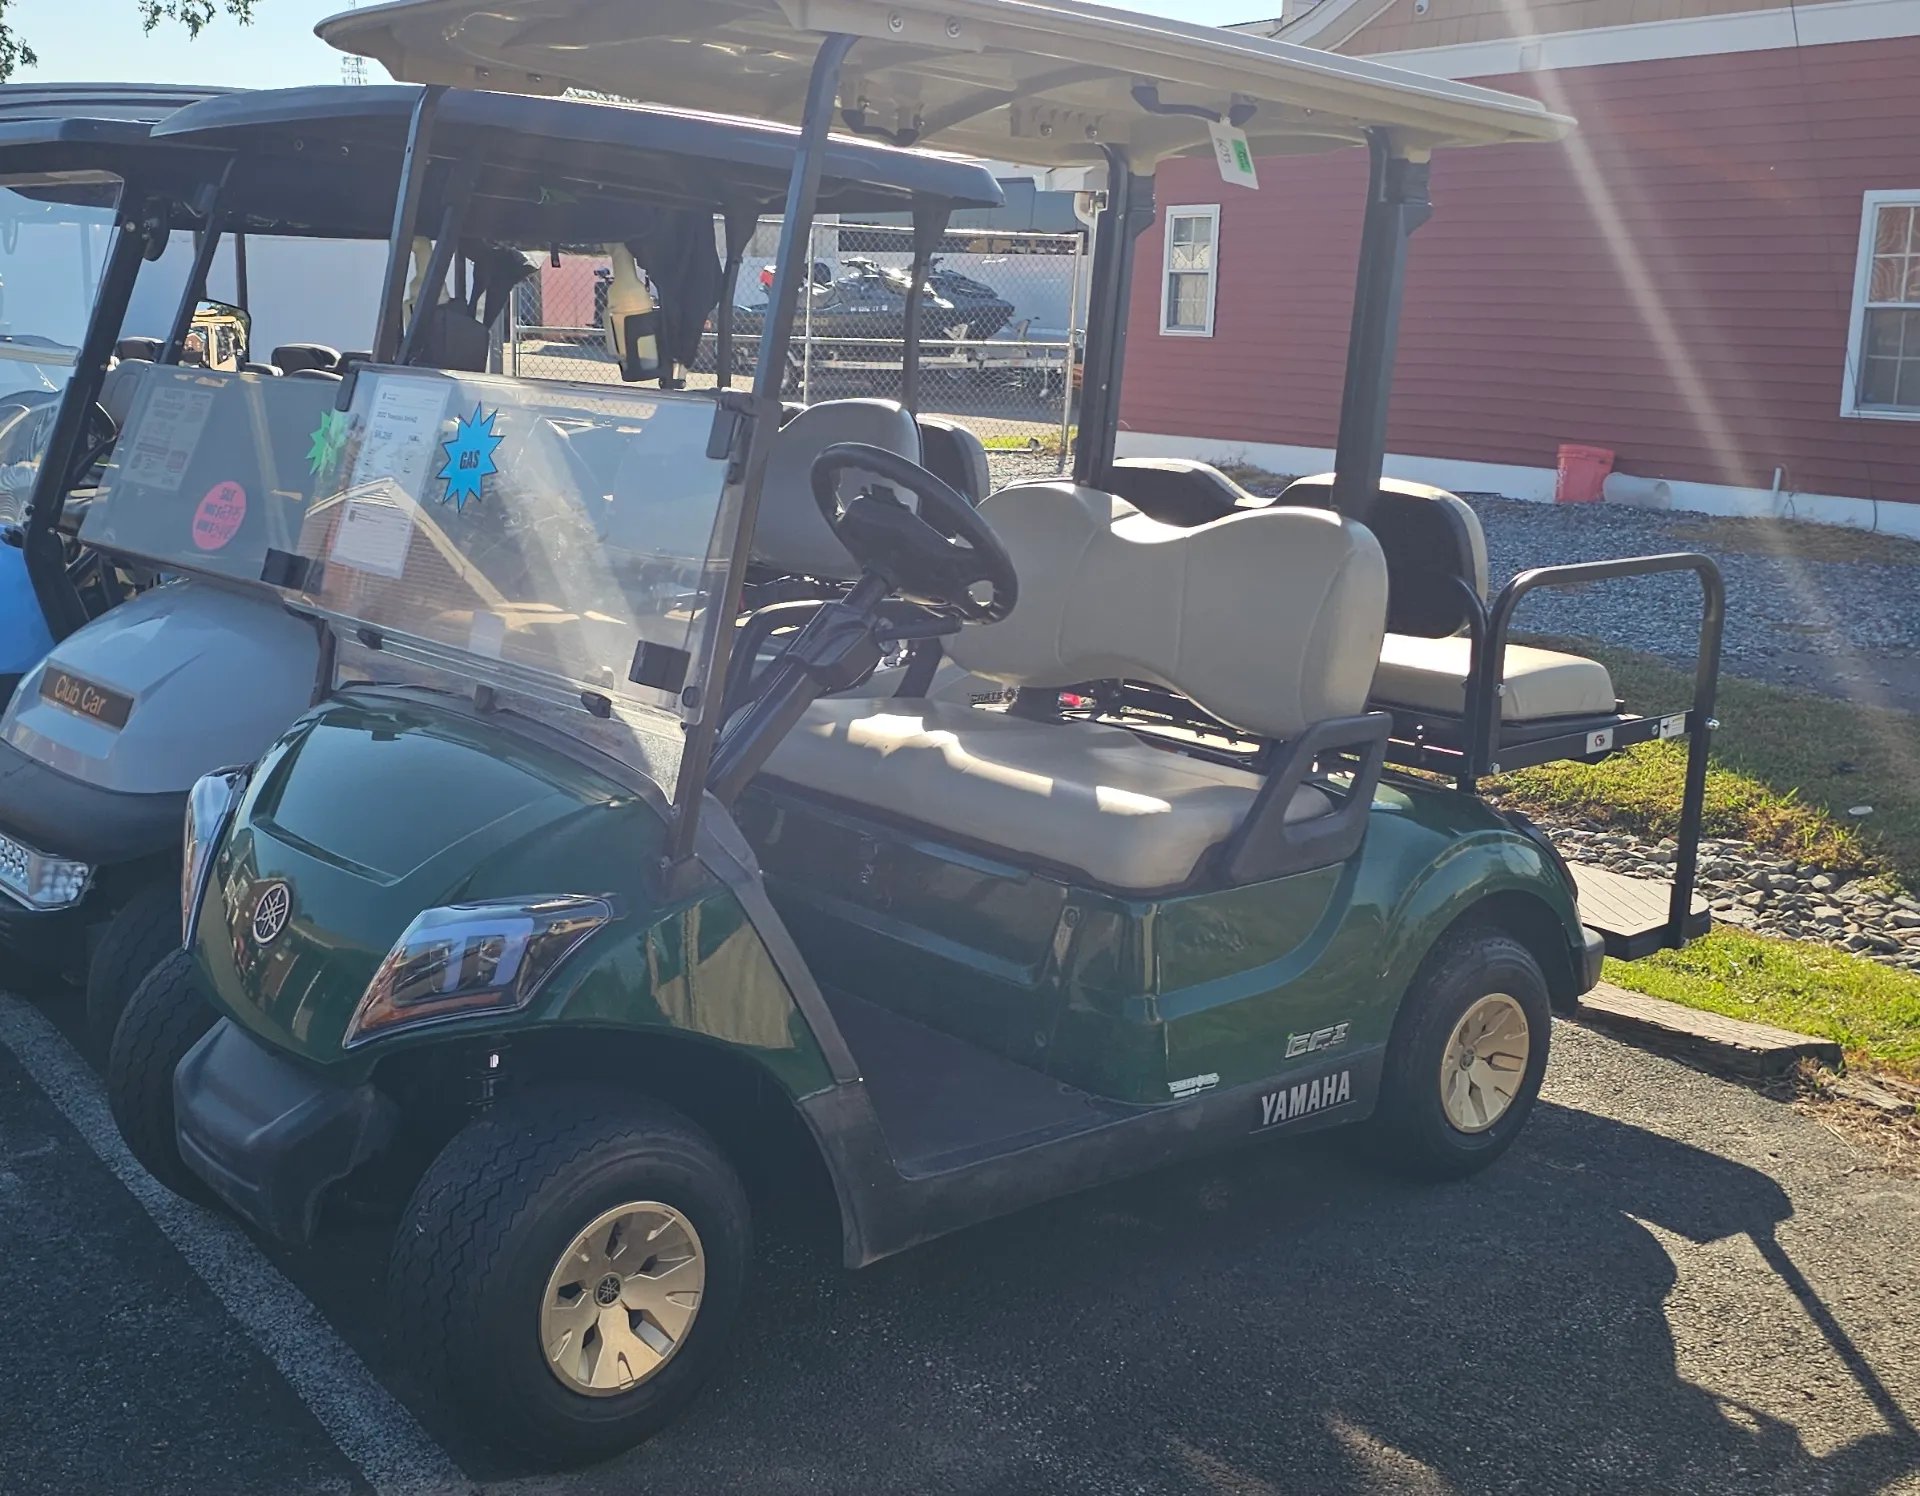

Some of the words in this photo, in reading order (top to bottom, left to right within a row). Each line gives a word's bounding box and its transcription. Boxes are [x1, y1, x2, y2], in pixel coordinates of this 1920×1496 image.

[460, 450, 480, 470] GAS
[55, 675, 80, 706] Club
[81, 686, 107, 716] Car
[1284, 1022, 1350, 1059] EFI
[1261, 1070, 1350, 1126] YAMAHA
